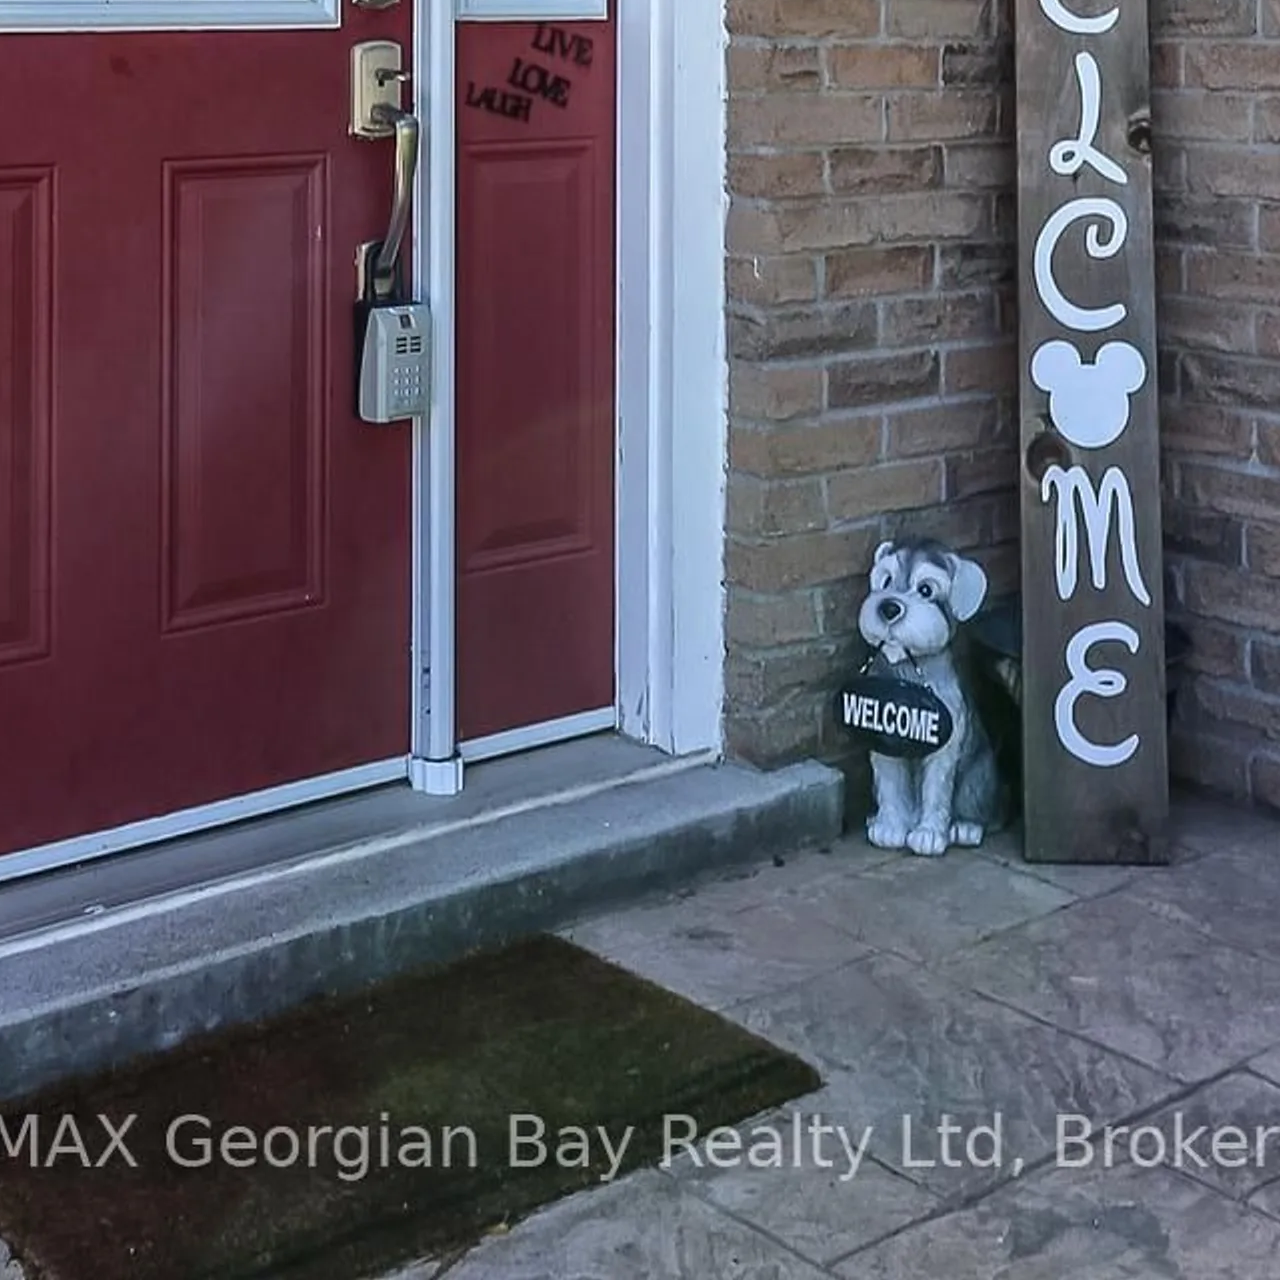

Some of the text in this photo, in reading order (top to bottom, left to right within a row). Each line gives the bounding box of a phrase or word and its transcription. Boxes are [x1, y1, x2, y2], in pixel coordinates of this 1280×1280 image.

[531, 23, 593, 67] LIVE
[464, 81, 533, 124] LAUGH
[507, 57, 571, 109] LOVE
[842, 692, 940, 745] WELCOME
